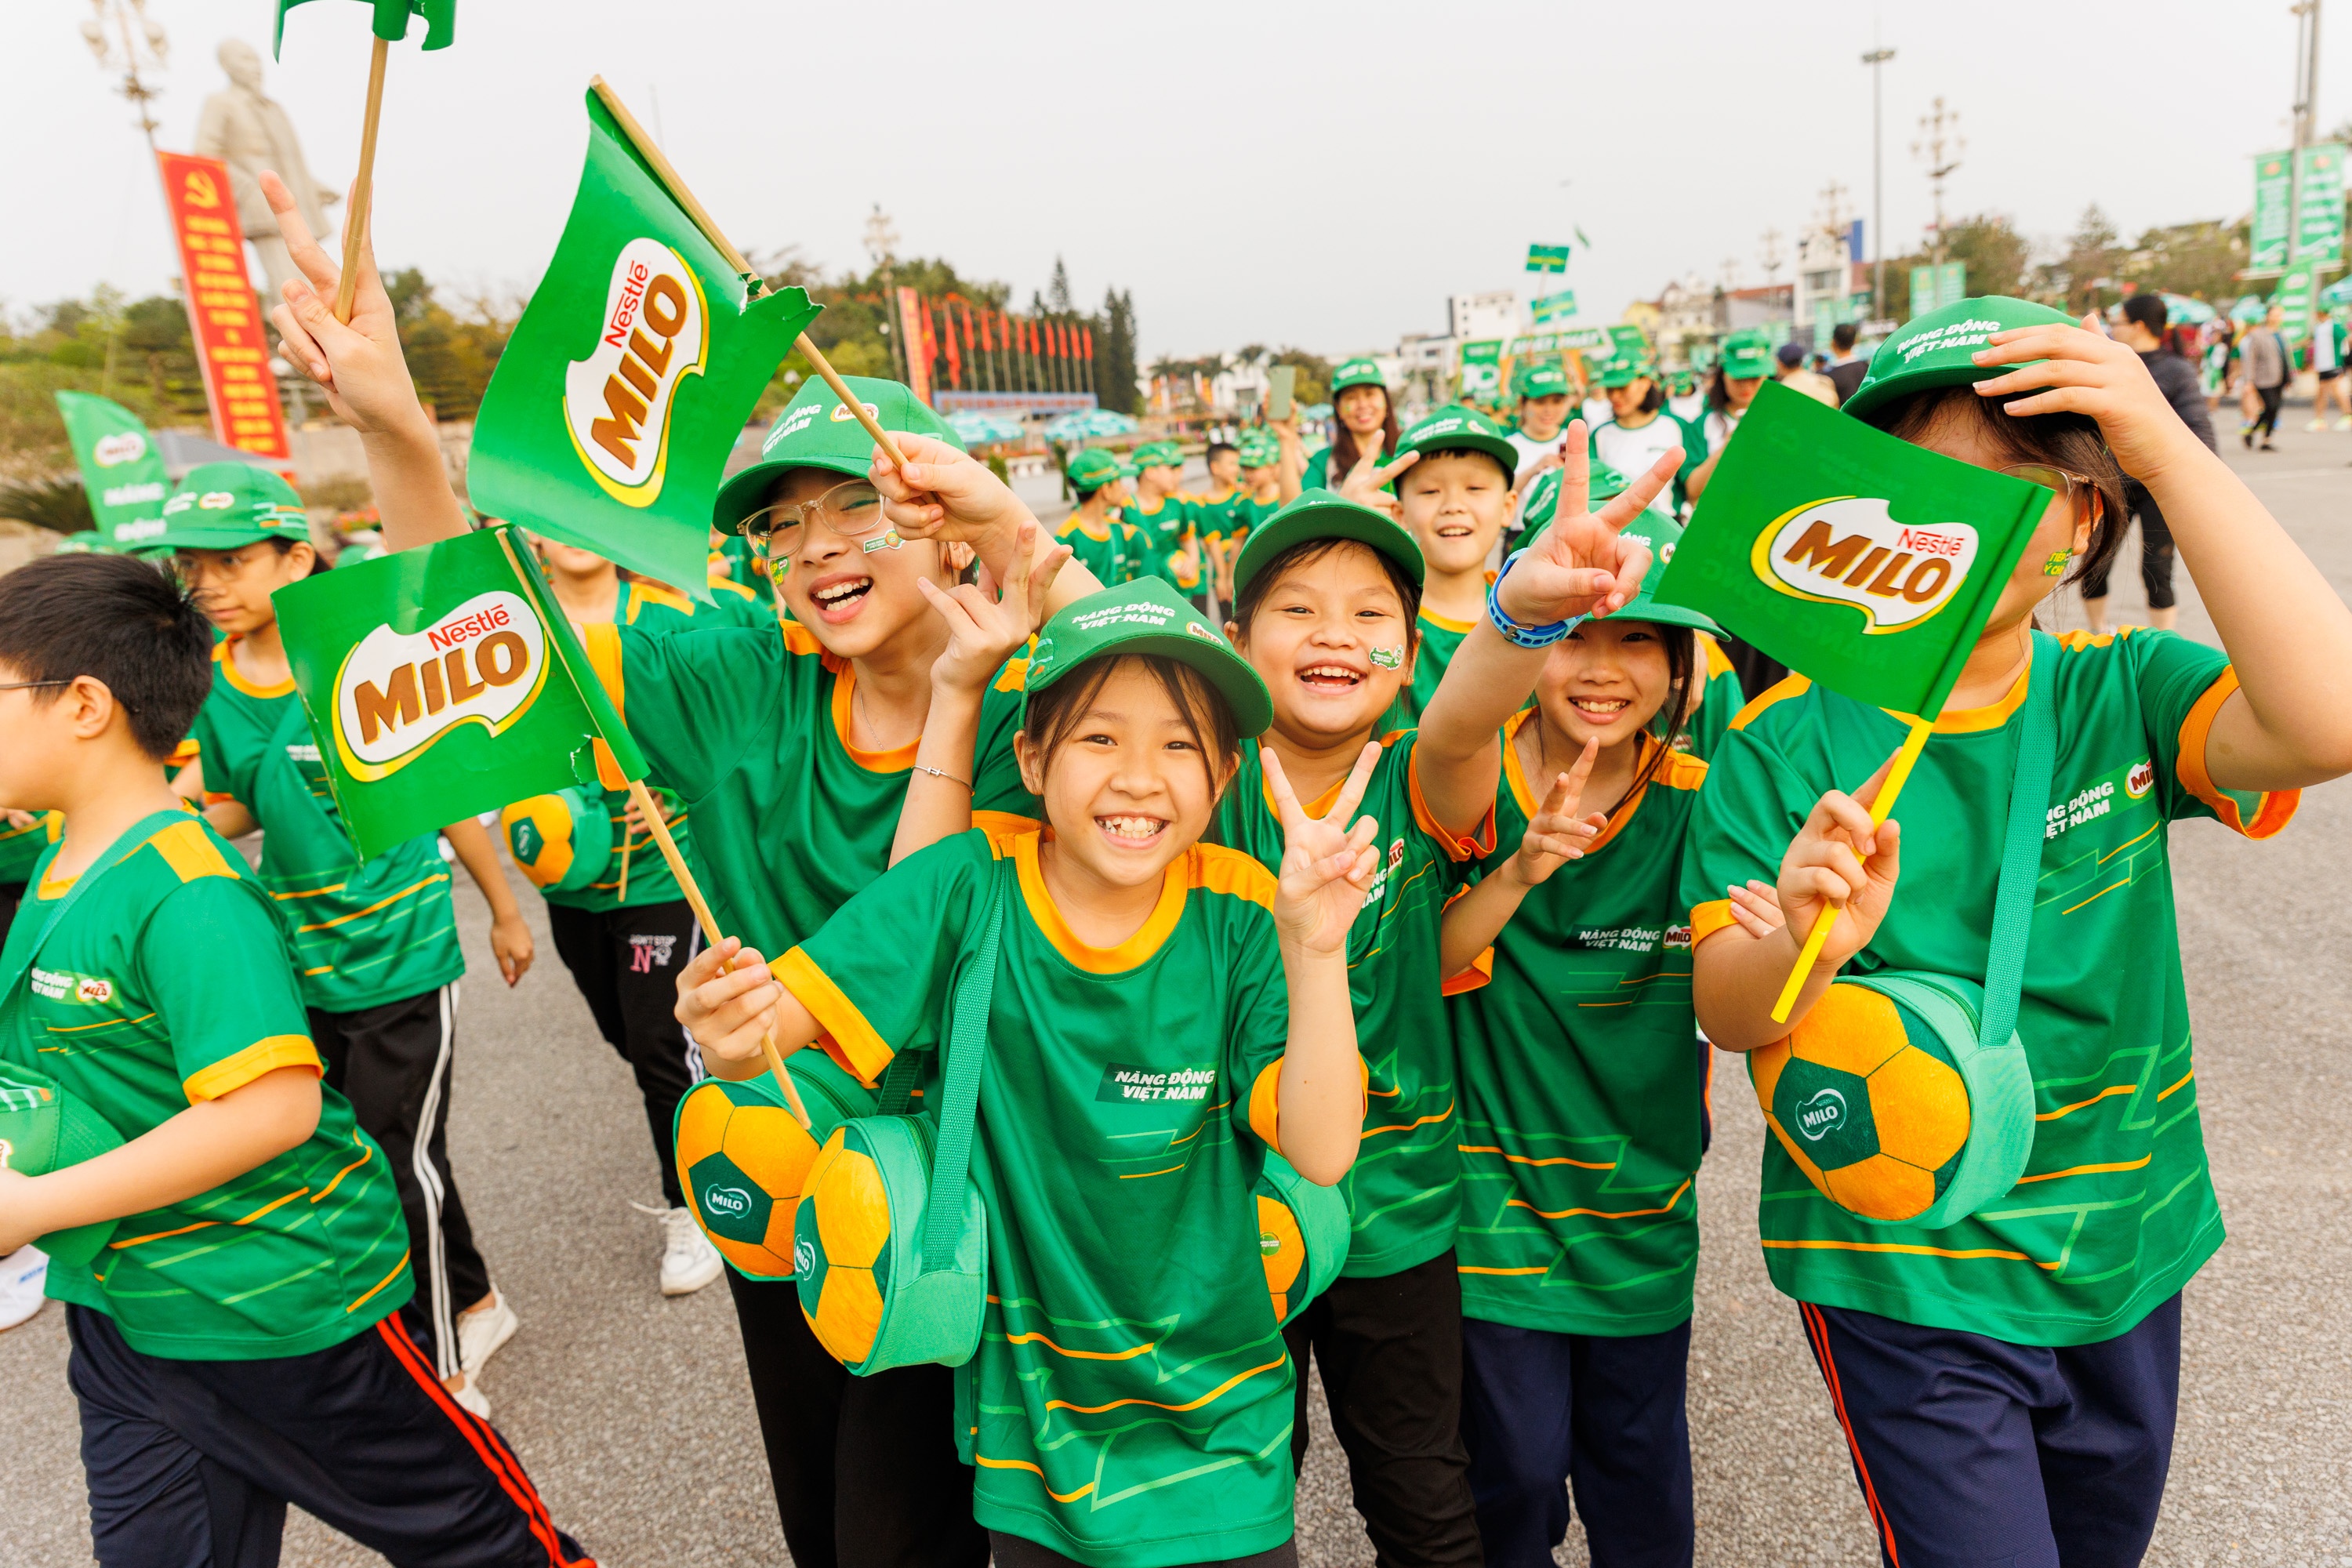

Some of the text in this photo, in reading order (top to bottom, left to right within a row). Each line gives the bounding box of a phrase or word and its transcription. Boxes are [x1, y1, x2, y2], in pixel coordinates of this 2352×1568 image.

[1943, 318, 2001, 336] ĐỘNG
[1903, 334, 1988, 364] VIỆT NAM
[591, 274, 689, 470] MILO
[1897, 528, 1965, 557] Nestlé
[1783, 520, 1952, 605] MILO
[1072, 601, 1176, 624] NĂNG ĐỘNG
[1080, 613, 1167, 630] VIỆT NAM
[427, 604, 510, 652] Nestlé
[354, 630, 531, 746] MILO
[2046, 782, 2114, 822] NG ĐỘNG
[2068, 799, 2111, 828] NAM
[1389, 846, 1403, 866] ILO
[1371, 868, 1387, 888] NG
[1579, 927, 1661, 941] NĂNG ĐỘNG
[1586, 938, 1653, 952] VIỆT NAM
[1666, 931, 1692, 942] MILO
[1114, 1068, 1216, 1087] NĂNG ĐỘNG
[1120, 1085, 1207, 1102] VIỆT NAM
[1803, 1105, 1838, 1128] MILO
[712, 1192, 743, 1211] MILO
[796, 1245, 810, 1271] MILO
